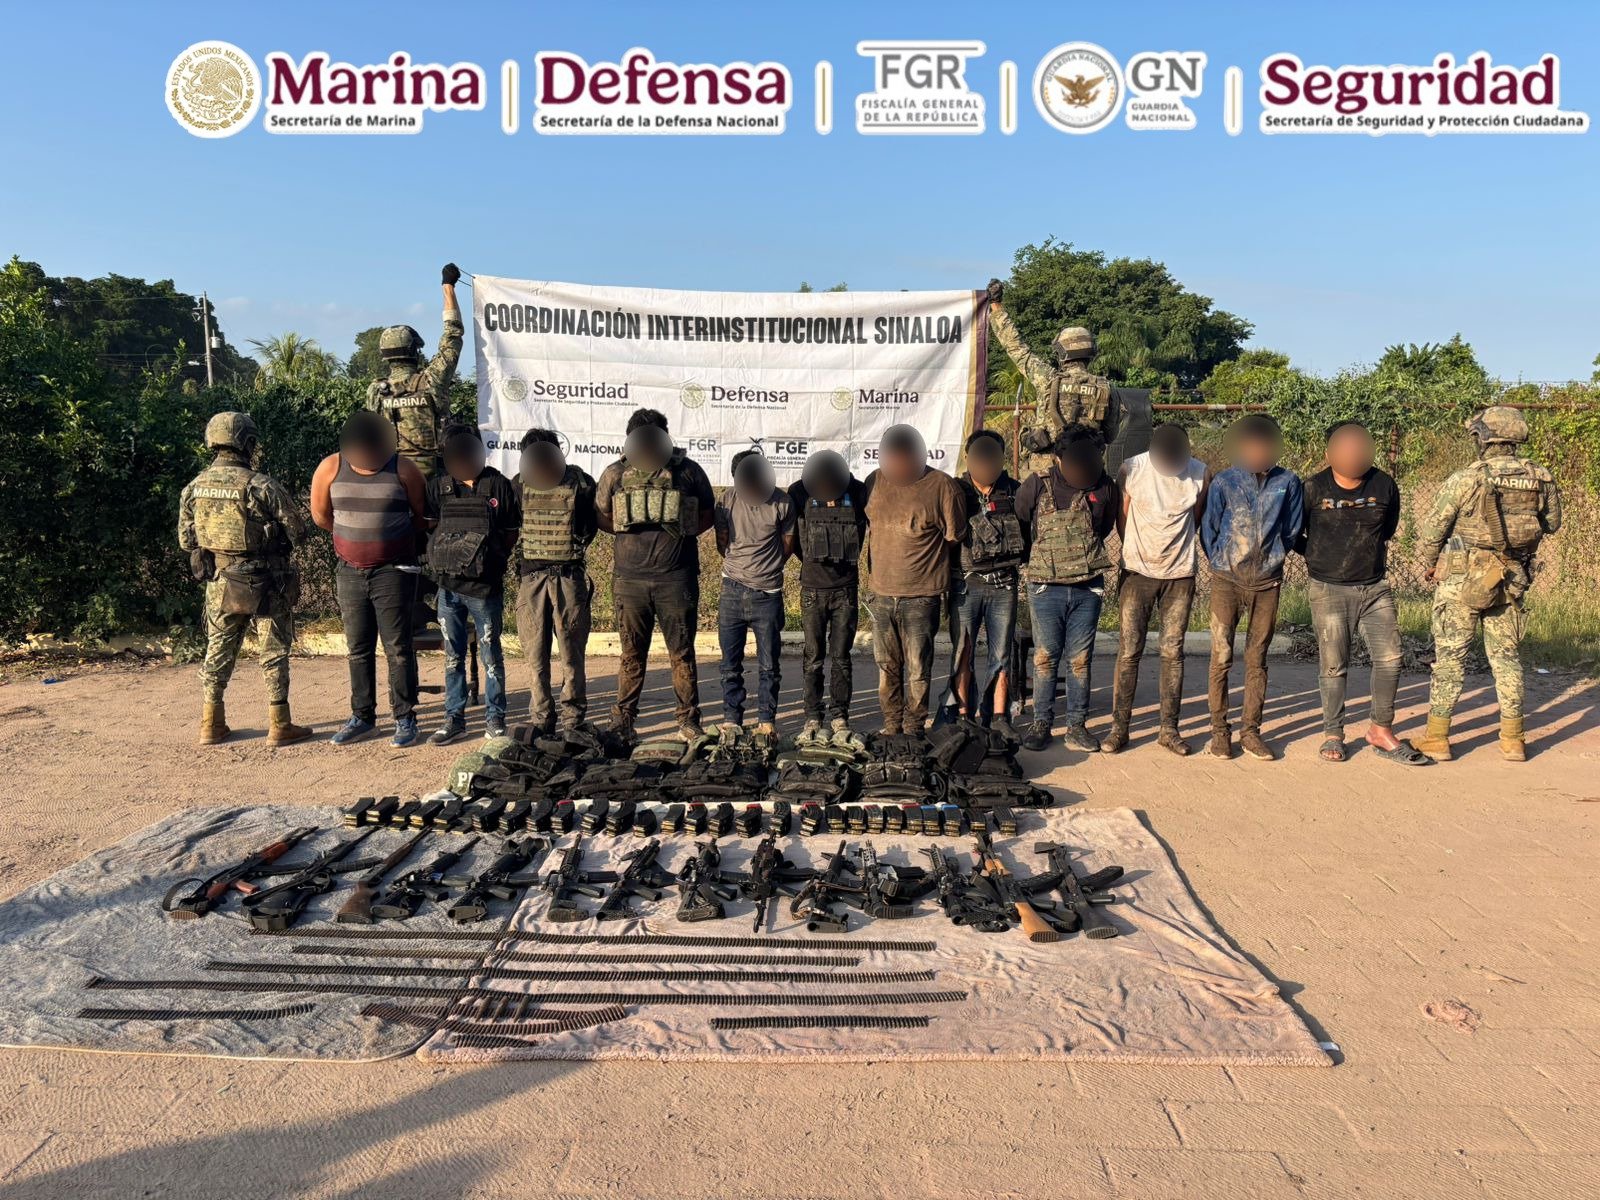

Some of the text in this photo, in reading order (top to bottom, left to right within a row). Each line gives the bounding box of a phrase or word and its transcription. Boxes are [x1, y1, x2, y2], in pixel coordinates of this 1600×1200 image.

[484, 302, 962, 345] COORDINACIÓN INTERINSTITUCIONAL SINALOA
[533, 379, 629, 400] Seguridad
[711, 385, 789, 403] Defensa
[858, 388, 919, 404] Marina
[383, 397, 428, 408] MARINA
[688, 438, 717, 452] FGR
[775, 441, 808, 455] FGE
[1487, 477, 1540, 489] MARINA
[193, 487, 240, 499] MARINA
